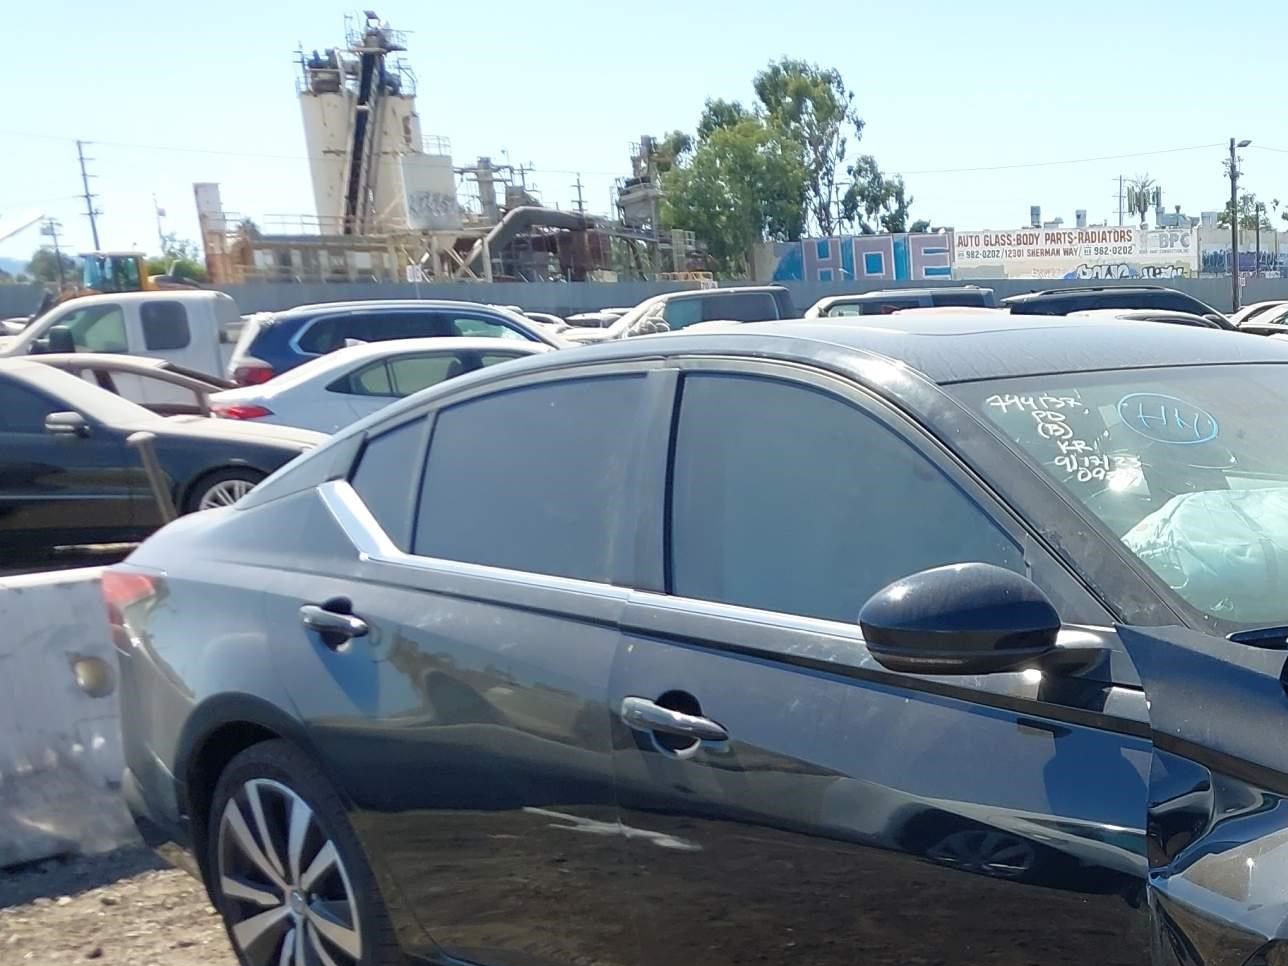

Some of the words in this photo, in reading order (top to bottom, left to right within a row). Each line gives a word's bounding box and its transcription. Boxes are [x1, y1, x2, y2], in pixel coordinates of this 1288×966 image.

[957, 234, 980, 248] AUTO
[1158, 231, 1191, 249] BPC
[1026, 248, 1061, 257] SHERMAN
